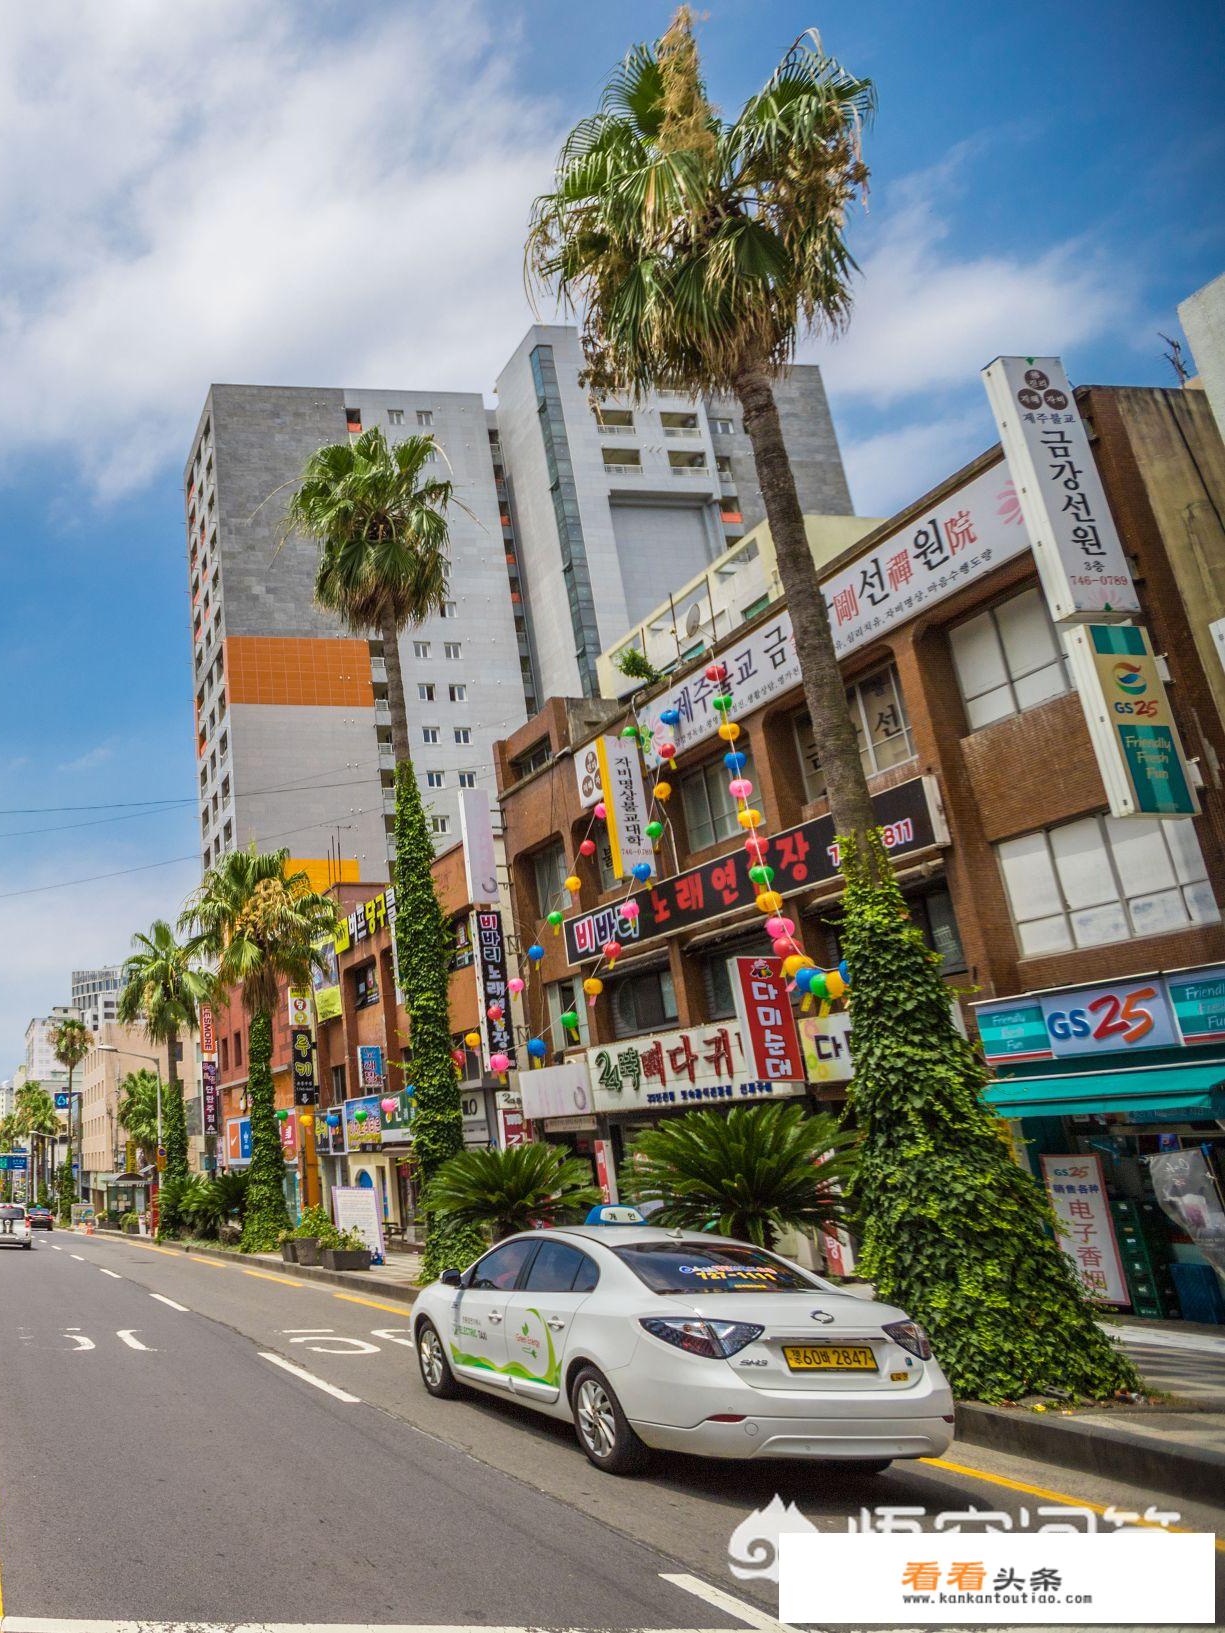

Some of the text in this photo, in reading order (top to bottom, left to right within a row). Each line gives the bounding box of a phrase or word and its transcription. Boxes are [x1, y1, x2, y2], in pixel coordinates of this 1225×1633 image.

[1022, 412, 1076, 425] 제주불교
[1039, 429, 1107, 557] 금강선원
[1070, 573, 1128, 587] 746-0789
[1114, 698, 1160, 718] GS25
[1124, 735, 1172, 753] Friendly
[1146, 765, 1169, 779] Fun
[573, 899, 640, 954] 비바리
[650, 832, 810, 924] 노래연장
[479, 914, 501, 963] 비바리
[1185, 983, 1225, 1001] Friendl
[486, 964, 511, 1048] 노래연장
[1047, 987, 1157, 1043] GS25
[992, 1011, 1026, 1026] Friendly
[1207, 1015, 1225, 1030] Fu
[203, 1007, 213, 1051] LESMORE
[752, 981, 793, 1079] 다미순대
[639, 1027, 745, 1088] 뼈다귀
[1053, 1165, 1090, 1179] GS25
[1069, 1197, 1108, 1291] 电子香烟
[695, 1271, 778, 1281] 727-1111
[831, 1350, 869, 1366] 2847
